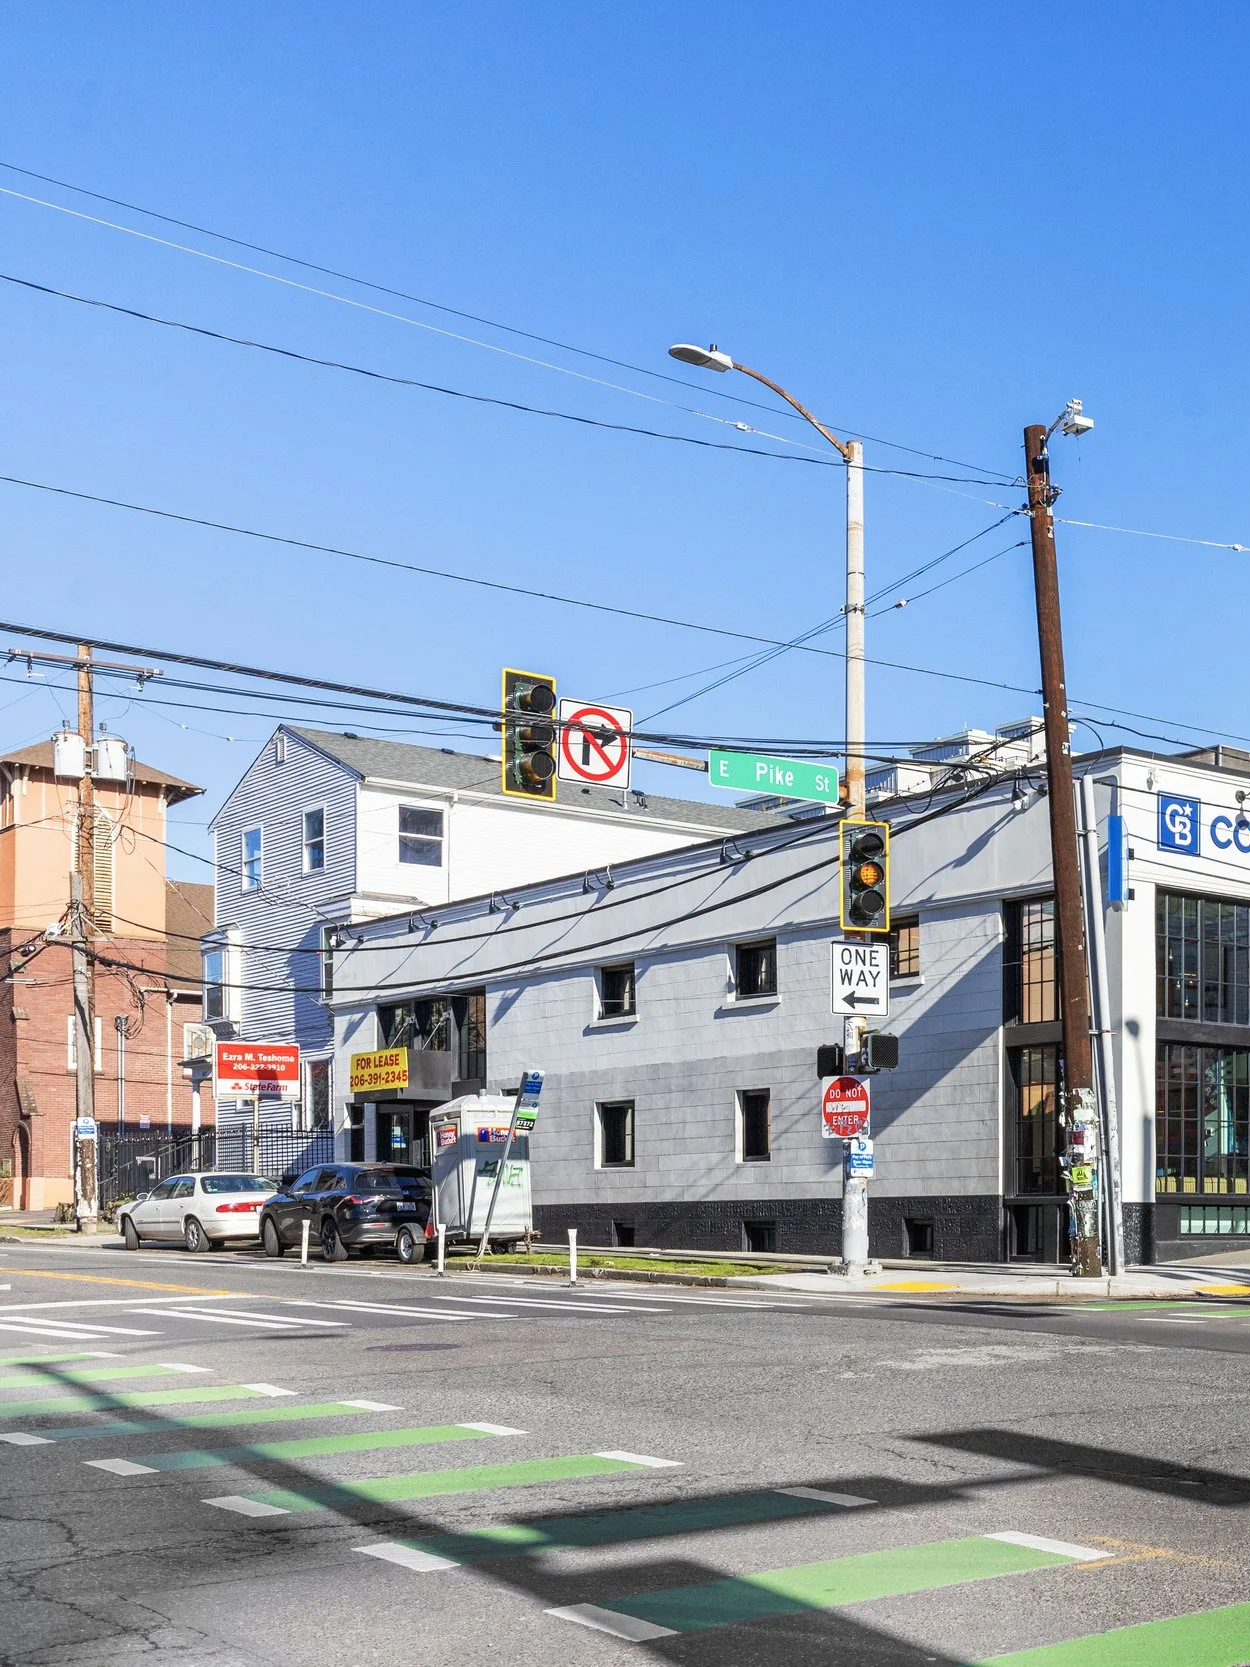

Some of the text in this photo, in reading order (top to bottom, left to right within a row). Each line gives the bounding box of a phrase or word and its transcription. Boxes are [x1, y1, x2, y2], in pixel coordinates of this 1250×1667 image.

[719, 759, 831, 793] E Pike St
[841, 947, 880, 967] ONE
[839, 968, 881, 988] WAY
[222, 1052, 295, 1063] Ezra M. Teshome
[356, 1053, 400, 1070] FOR LEASE
[232, 1063, 286, 1072] 206-322-3910
[350, 1069, 408, 1088] 206-391-2345
[829, 1087, 862, 1099] DO NOT
[832, 1115, 859, 1125] ENTER
